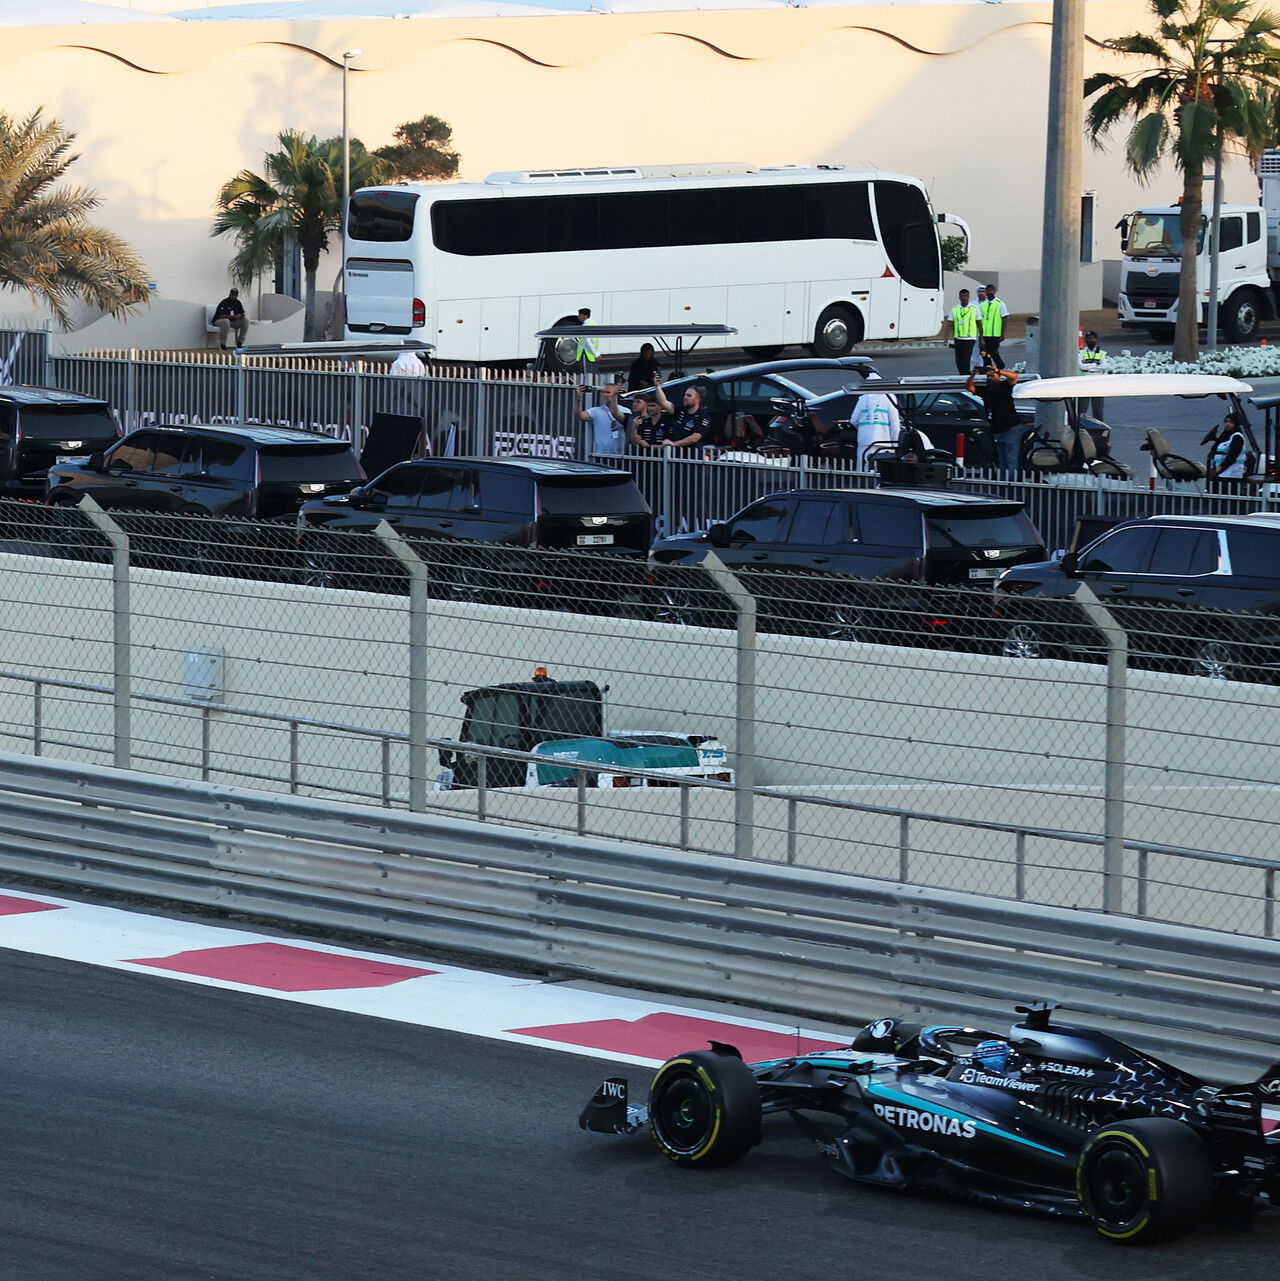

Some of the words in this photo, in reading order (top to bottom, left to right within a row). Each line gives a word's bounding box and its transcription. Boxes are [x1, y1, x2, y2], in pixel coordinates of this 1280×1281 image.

[1046, 1062, 1087, 1077] SOLERA
[601, 1081, 626, 1099] IWC
[975, 1070, 1040, 1092] TeamViewer
[873, 1103, 978, 1139] PETRONAS
